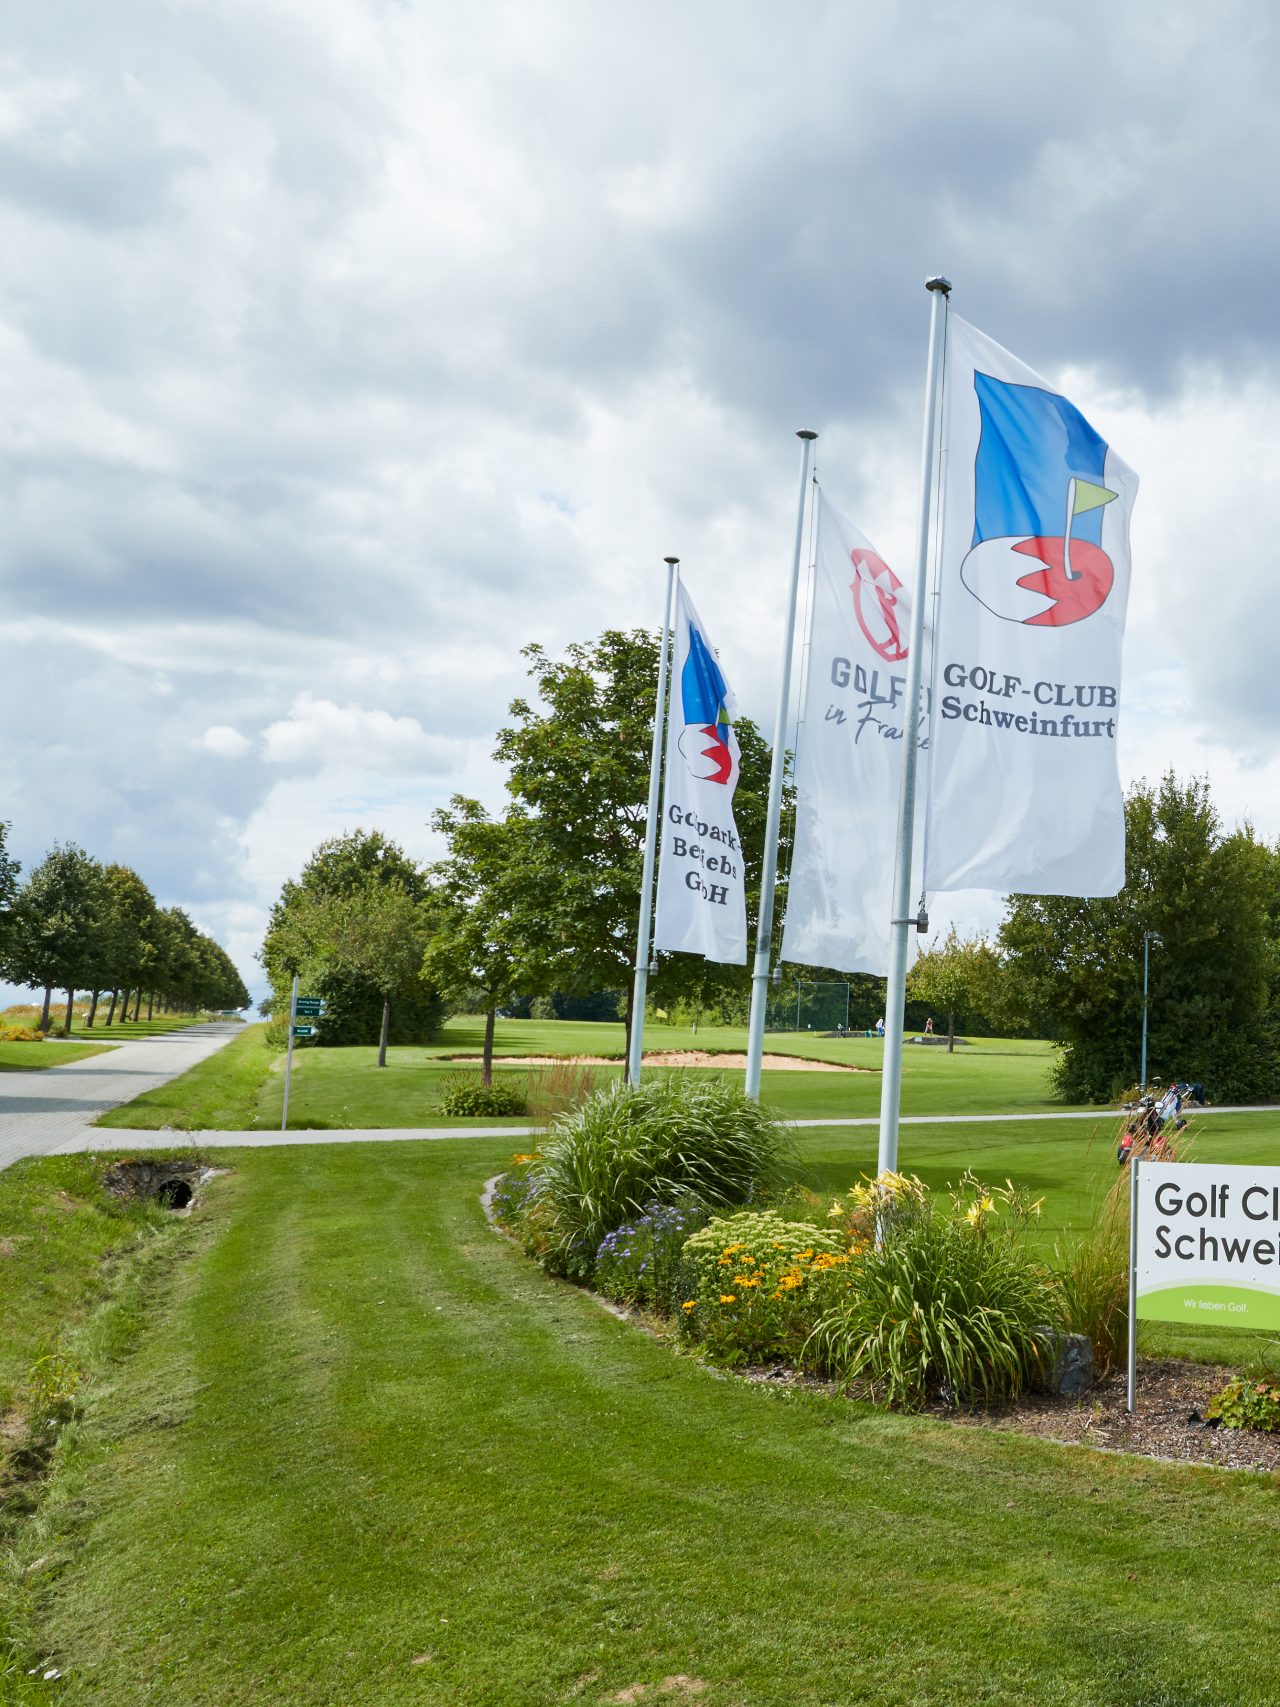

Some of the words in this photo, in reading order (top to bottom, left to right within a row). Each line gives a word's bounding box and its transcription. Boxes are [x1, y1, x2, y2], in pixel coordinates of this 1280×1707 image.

[943, 663, 1117, 708] GOLF-CLUB
[824, 704, 847, 725] in
[941, 696, 1116, 739] Schweinfurt
[685, 871, 730, 906] GbH
[1154, 1182, 1230, 1218] Golf
[1183, 1298, 1197, 1309] Wir
[1198, 1299, 1226, 1311] lieben
[1227, 1302, 1249, 1313] Golf.
